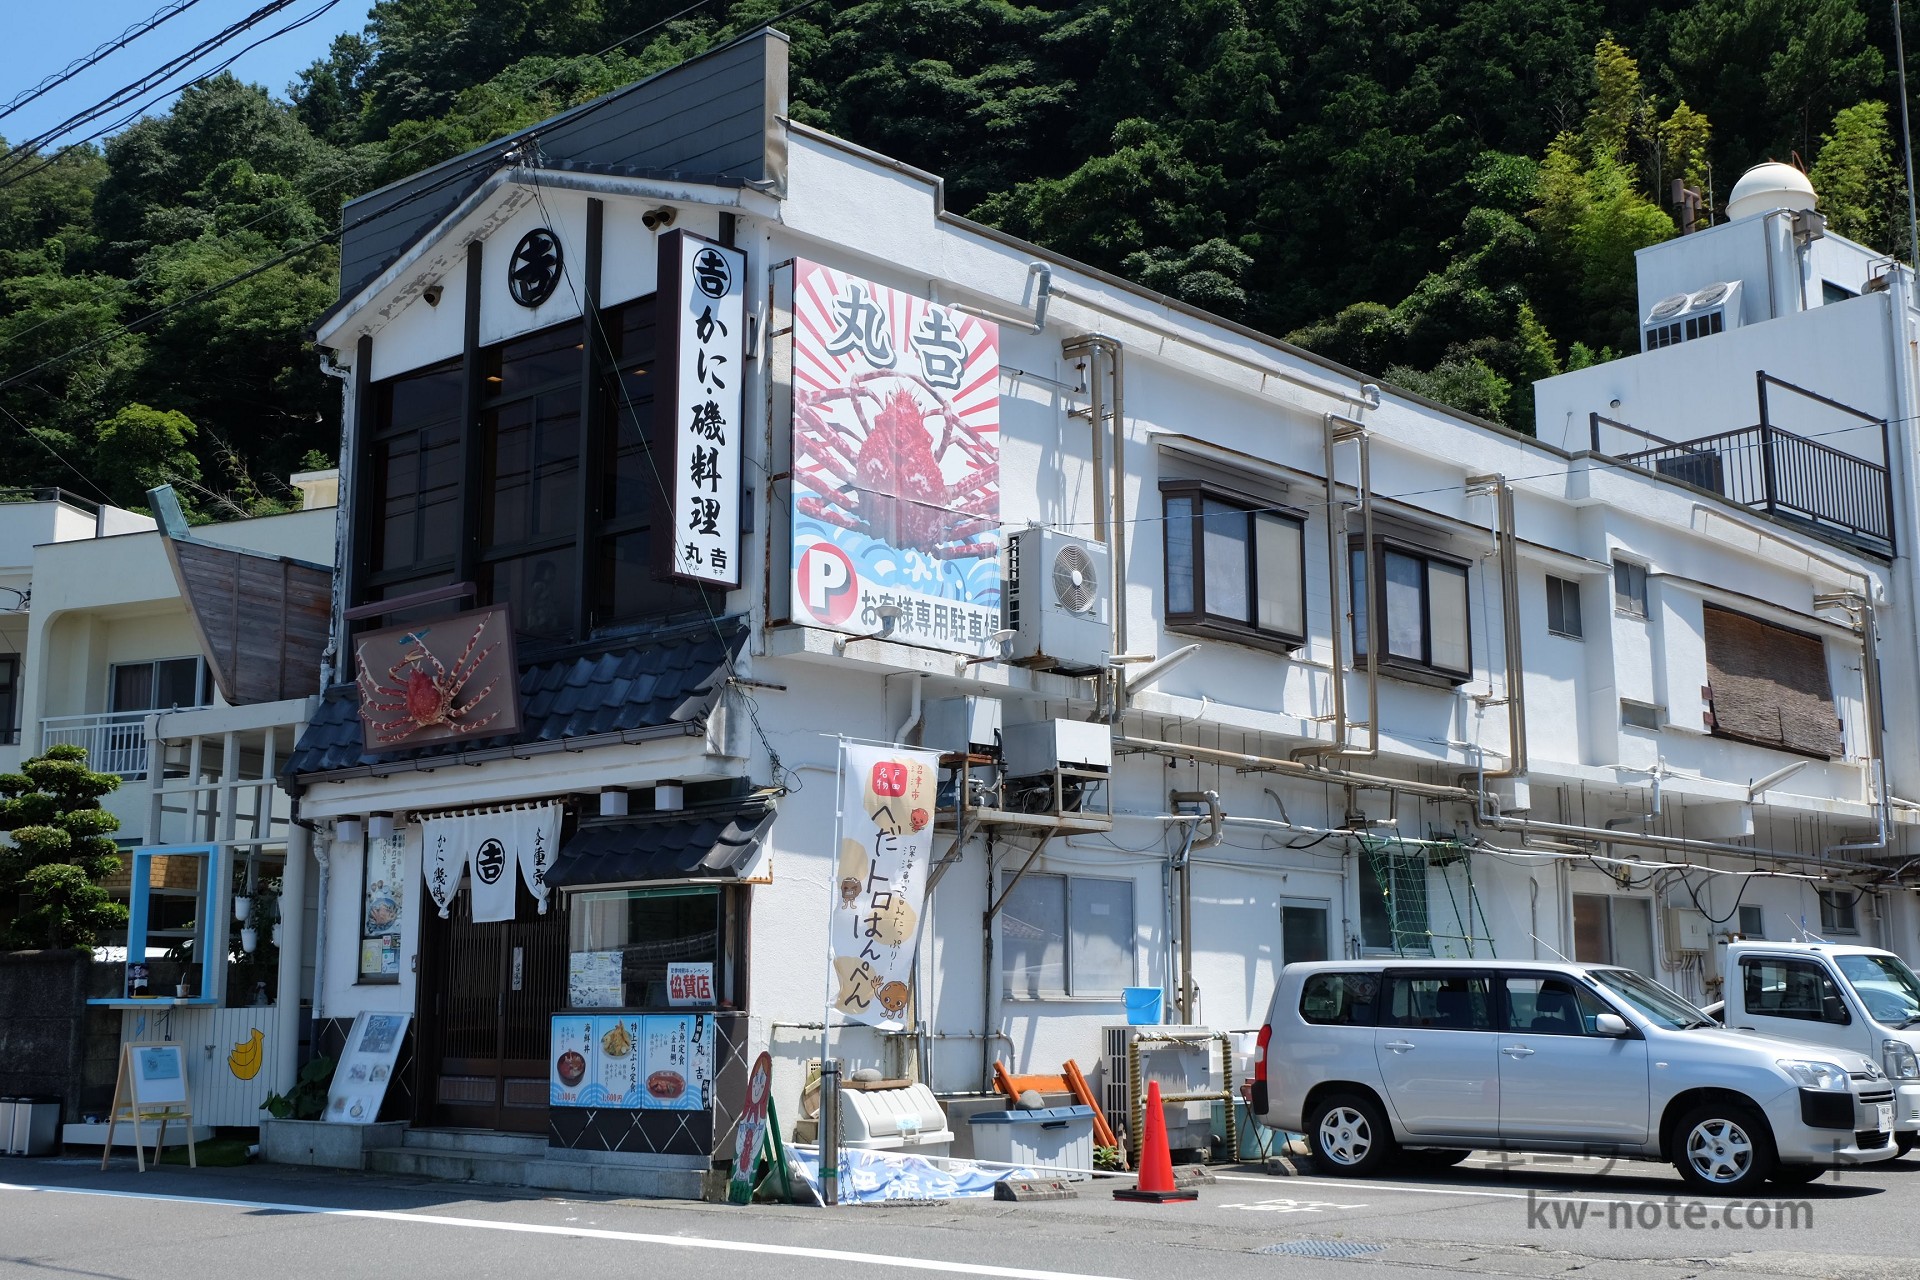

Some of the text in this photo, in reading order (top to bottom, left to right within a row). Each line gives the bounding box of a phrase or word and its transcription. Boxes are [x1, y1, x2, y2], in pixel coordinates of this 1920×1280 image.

[826, 283, 968, 390] 丸吉
[685, 542, 727, 569] 丸吉
[809, 549, 852, 615] P
[876, 768, 888, 790] 名物
[845, 805, 901, 1008] へだトロはんぺん
[670, 974, 711, 999] 協賛店
